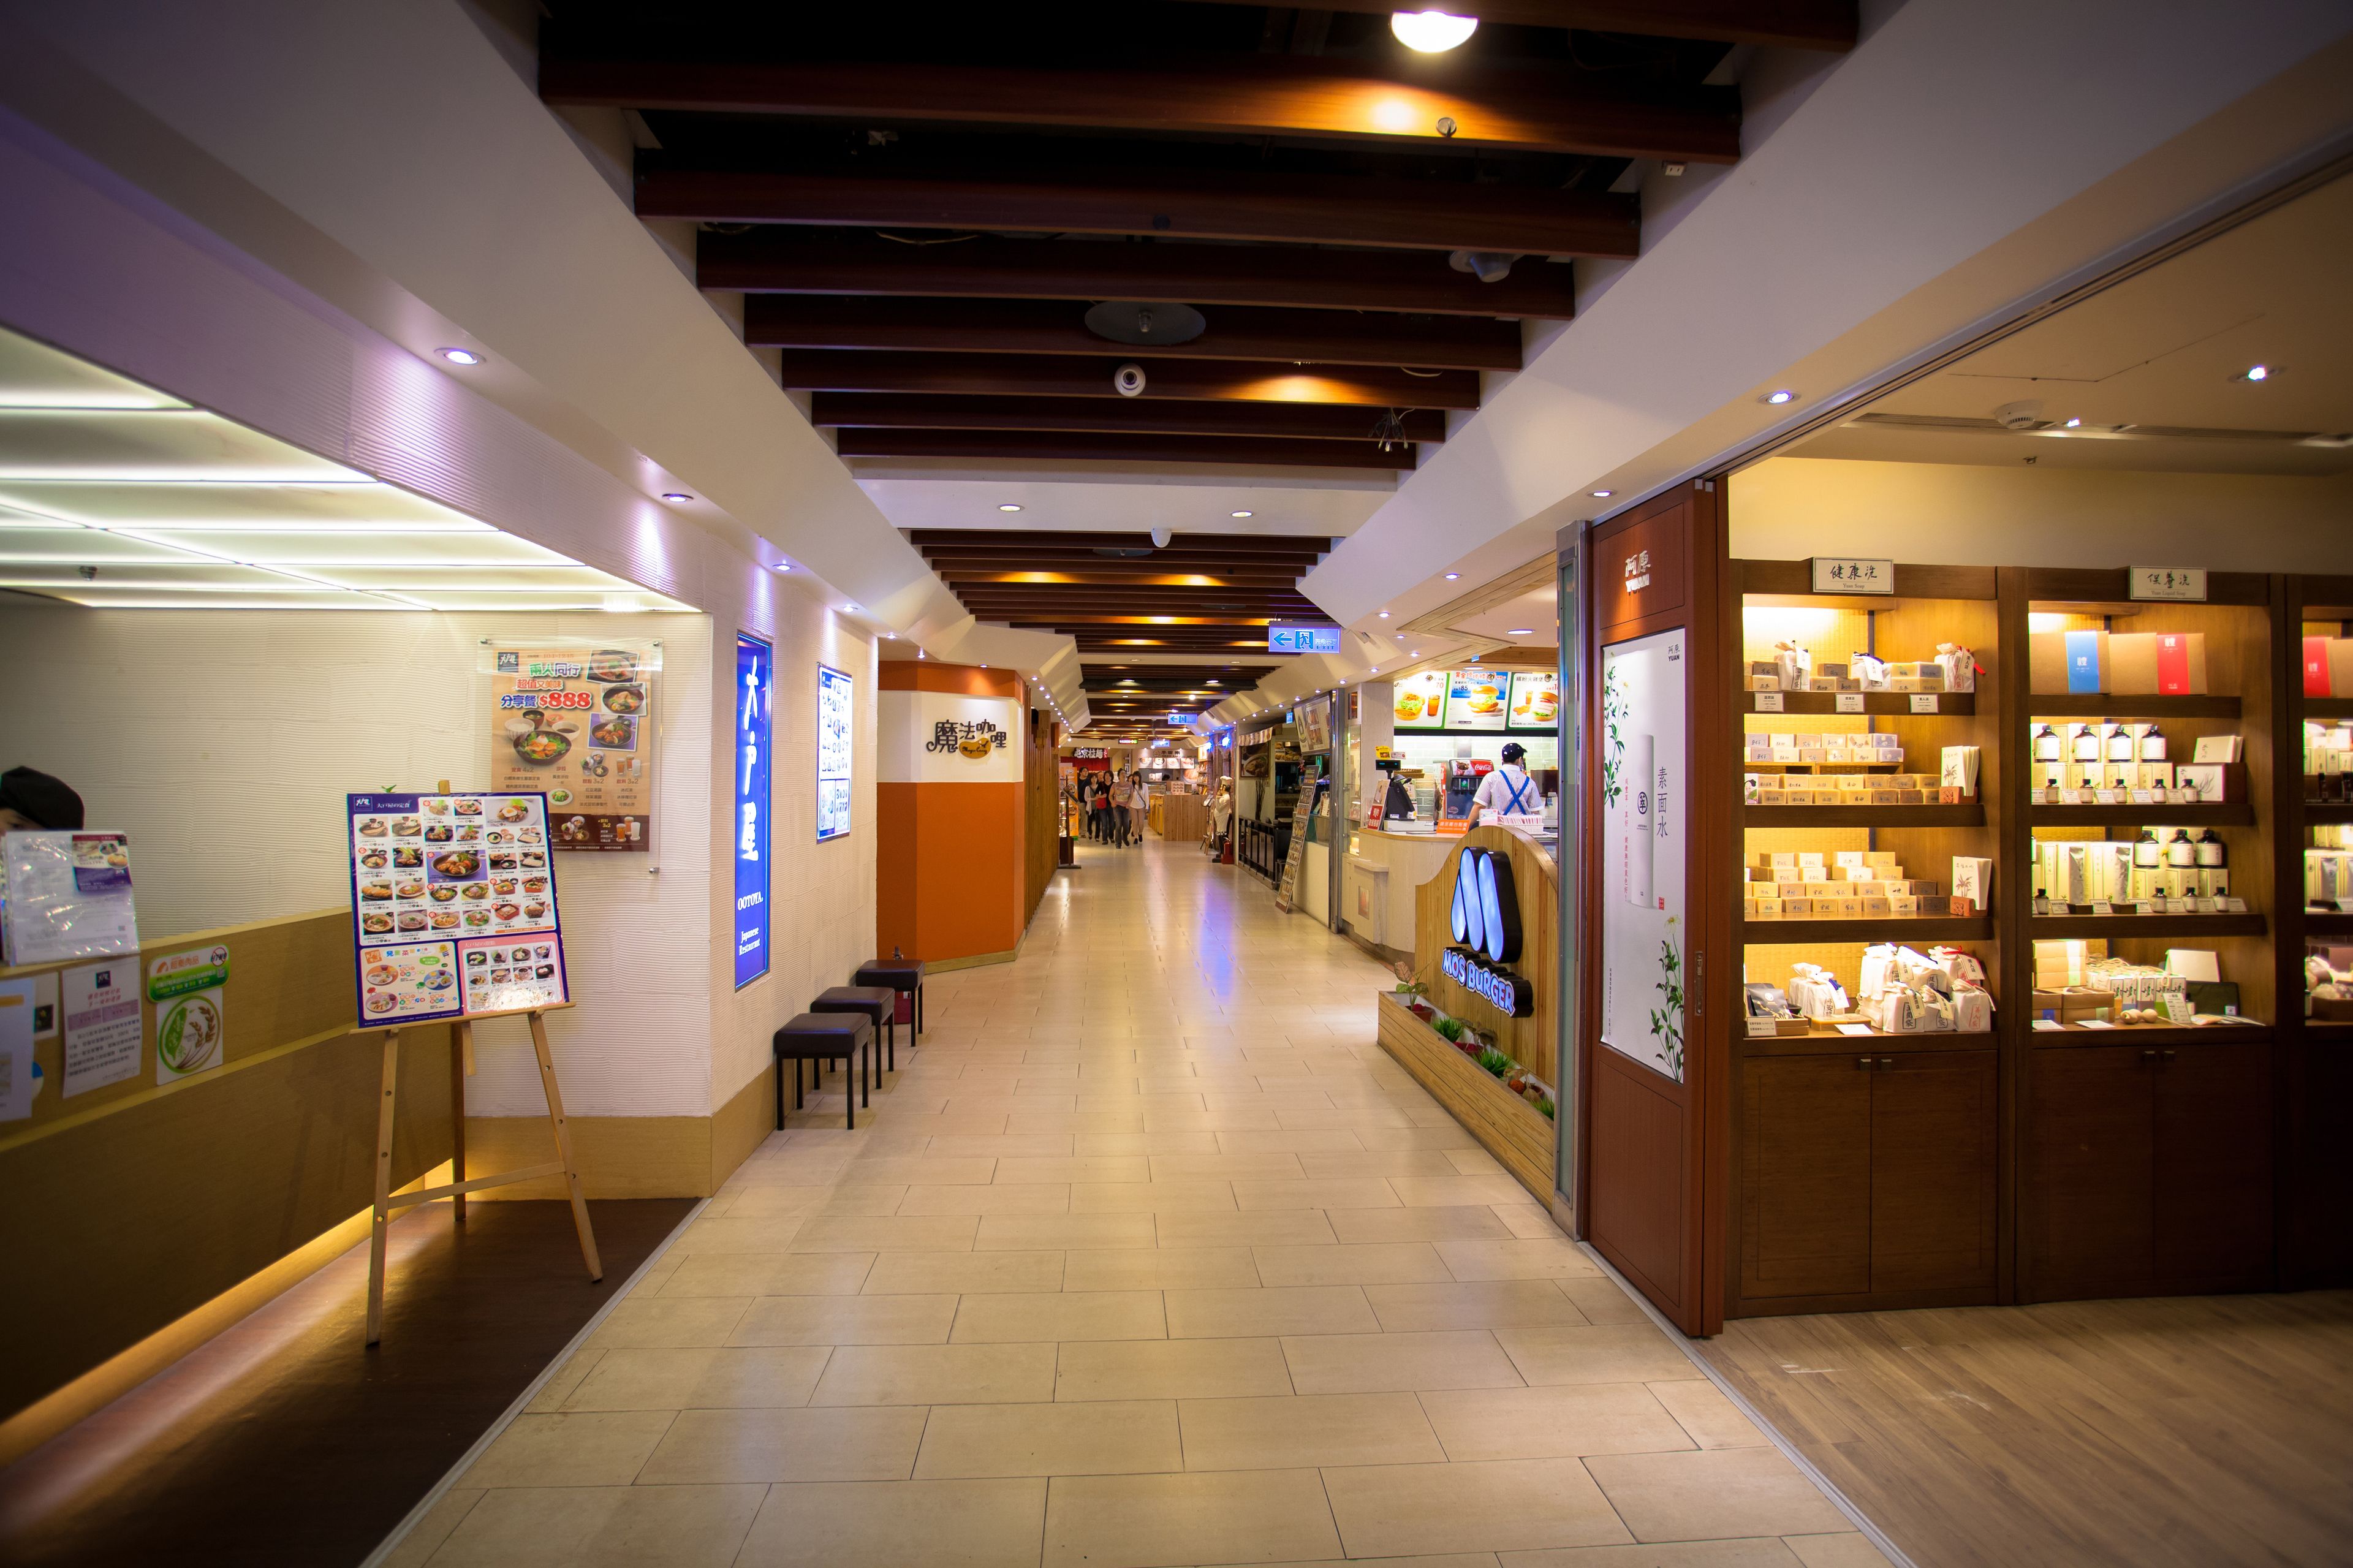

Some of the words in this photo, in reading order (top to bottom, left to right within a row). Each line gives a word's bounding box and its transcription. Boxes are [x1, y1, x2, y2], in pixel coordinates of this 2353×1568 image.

[1625, 550, 1651, 577] 阿原
[1830, 563, 1877, 580] 健康洗
[529, 662, 580, 676] 兩人同行
[517, 678, 563, 689] 超值又美味
[501, 695, 537, 707] 分享餐
[539, 692, 591, 708] $888
[926, 719, 1007, 753] 魔法咖哩
[1656, 767, 1668, 838] 素面水
[741, 927, 759, 944] Japanese
[739, 938, 760, 956] Restaurant
[1442, 949, 1466, 986] MOS
[1466, 960, 1515, 1017] BURGER
